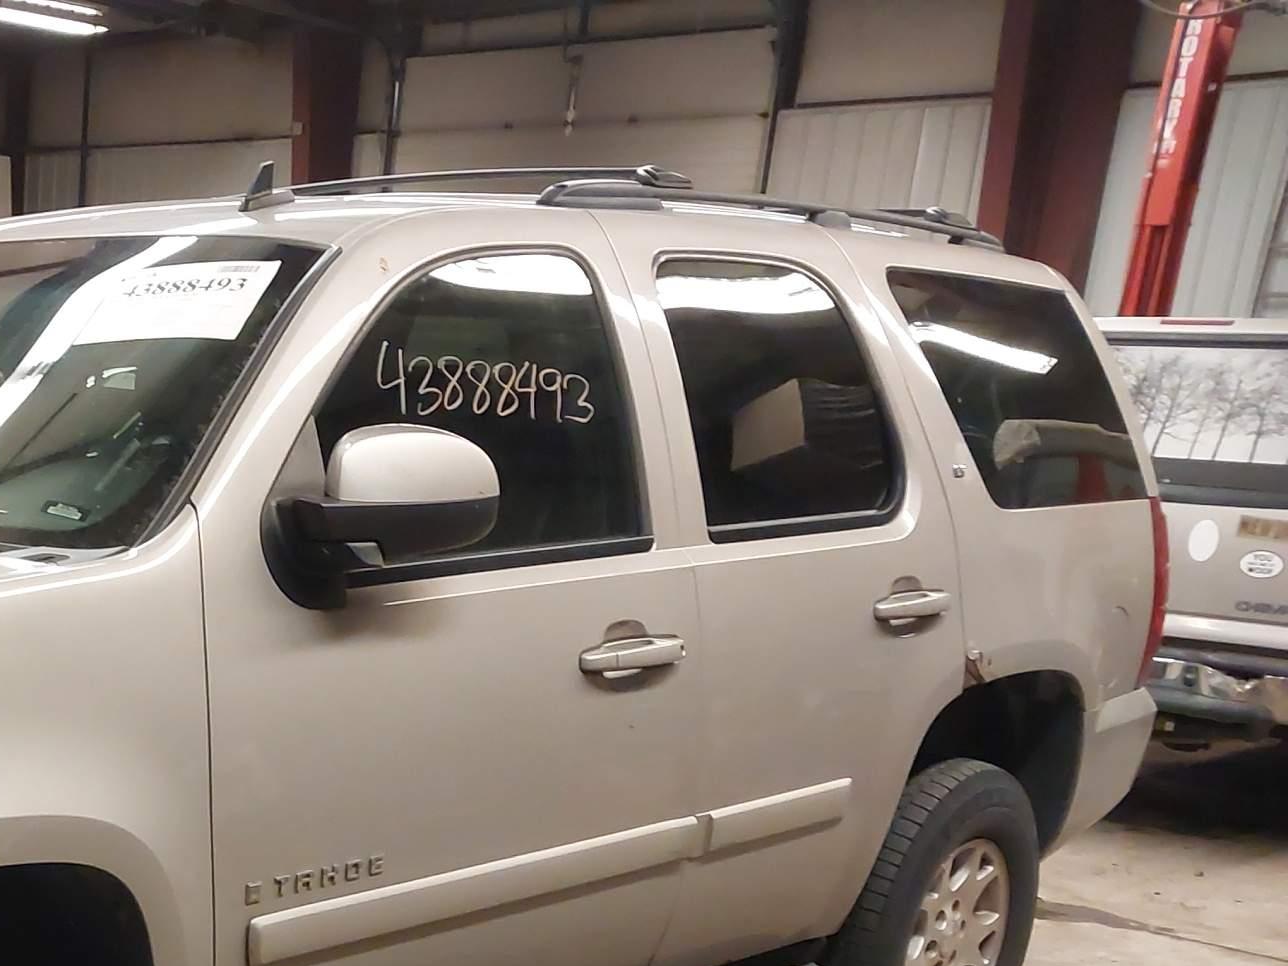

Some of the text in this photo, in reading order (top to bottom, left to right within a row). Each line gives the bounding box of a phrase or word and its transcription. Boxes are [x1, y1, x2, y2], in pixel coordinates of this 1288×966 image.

[123, 278, 248, 297] 43888493
[377, 341, 595, 423] 43888493
[273, 855, 385, 897] TAHOE
